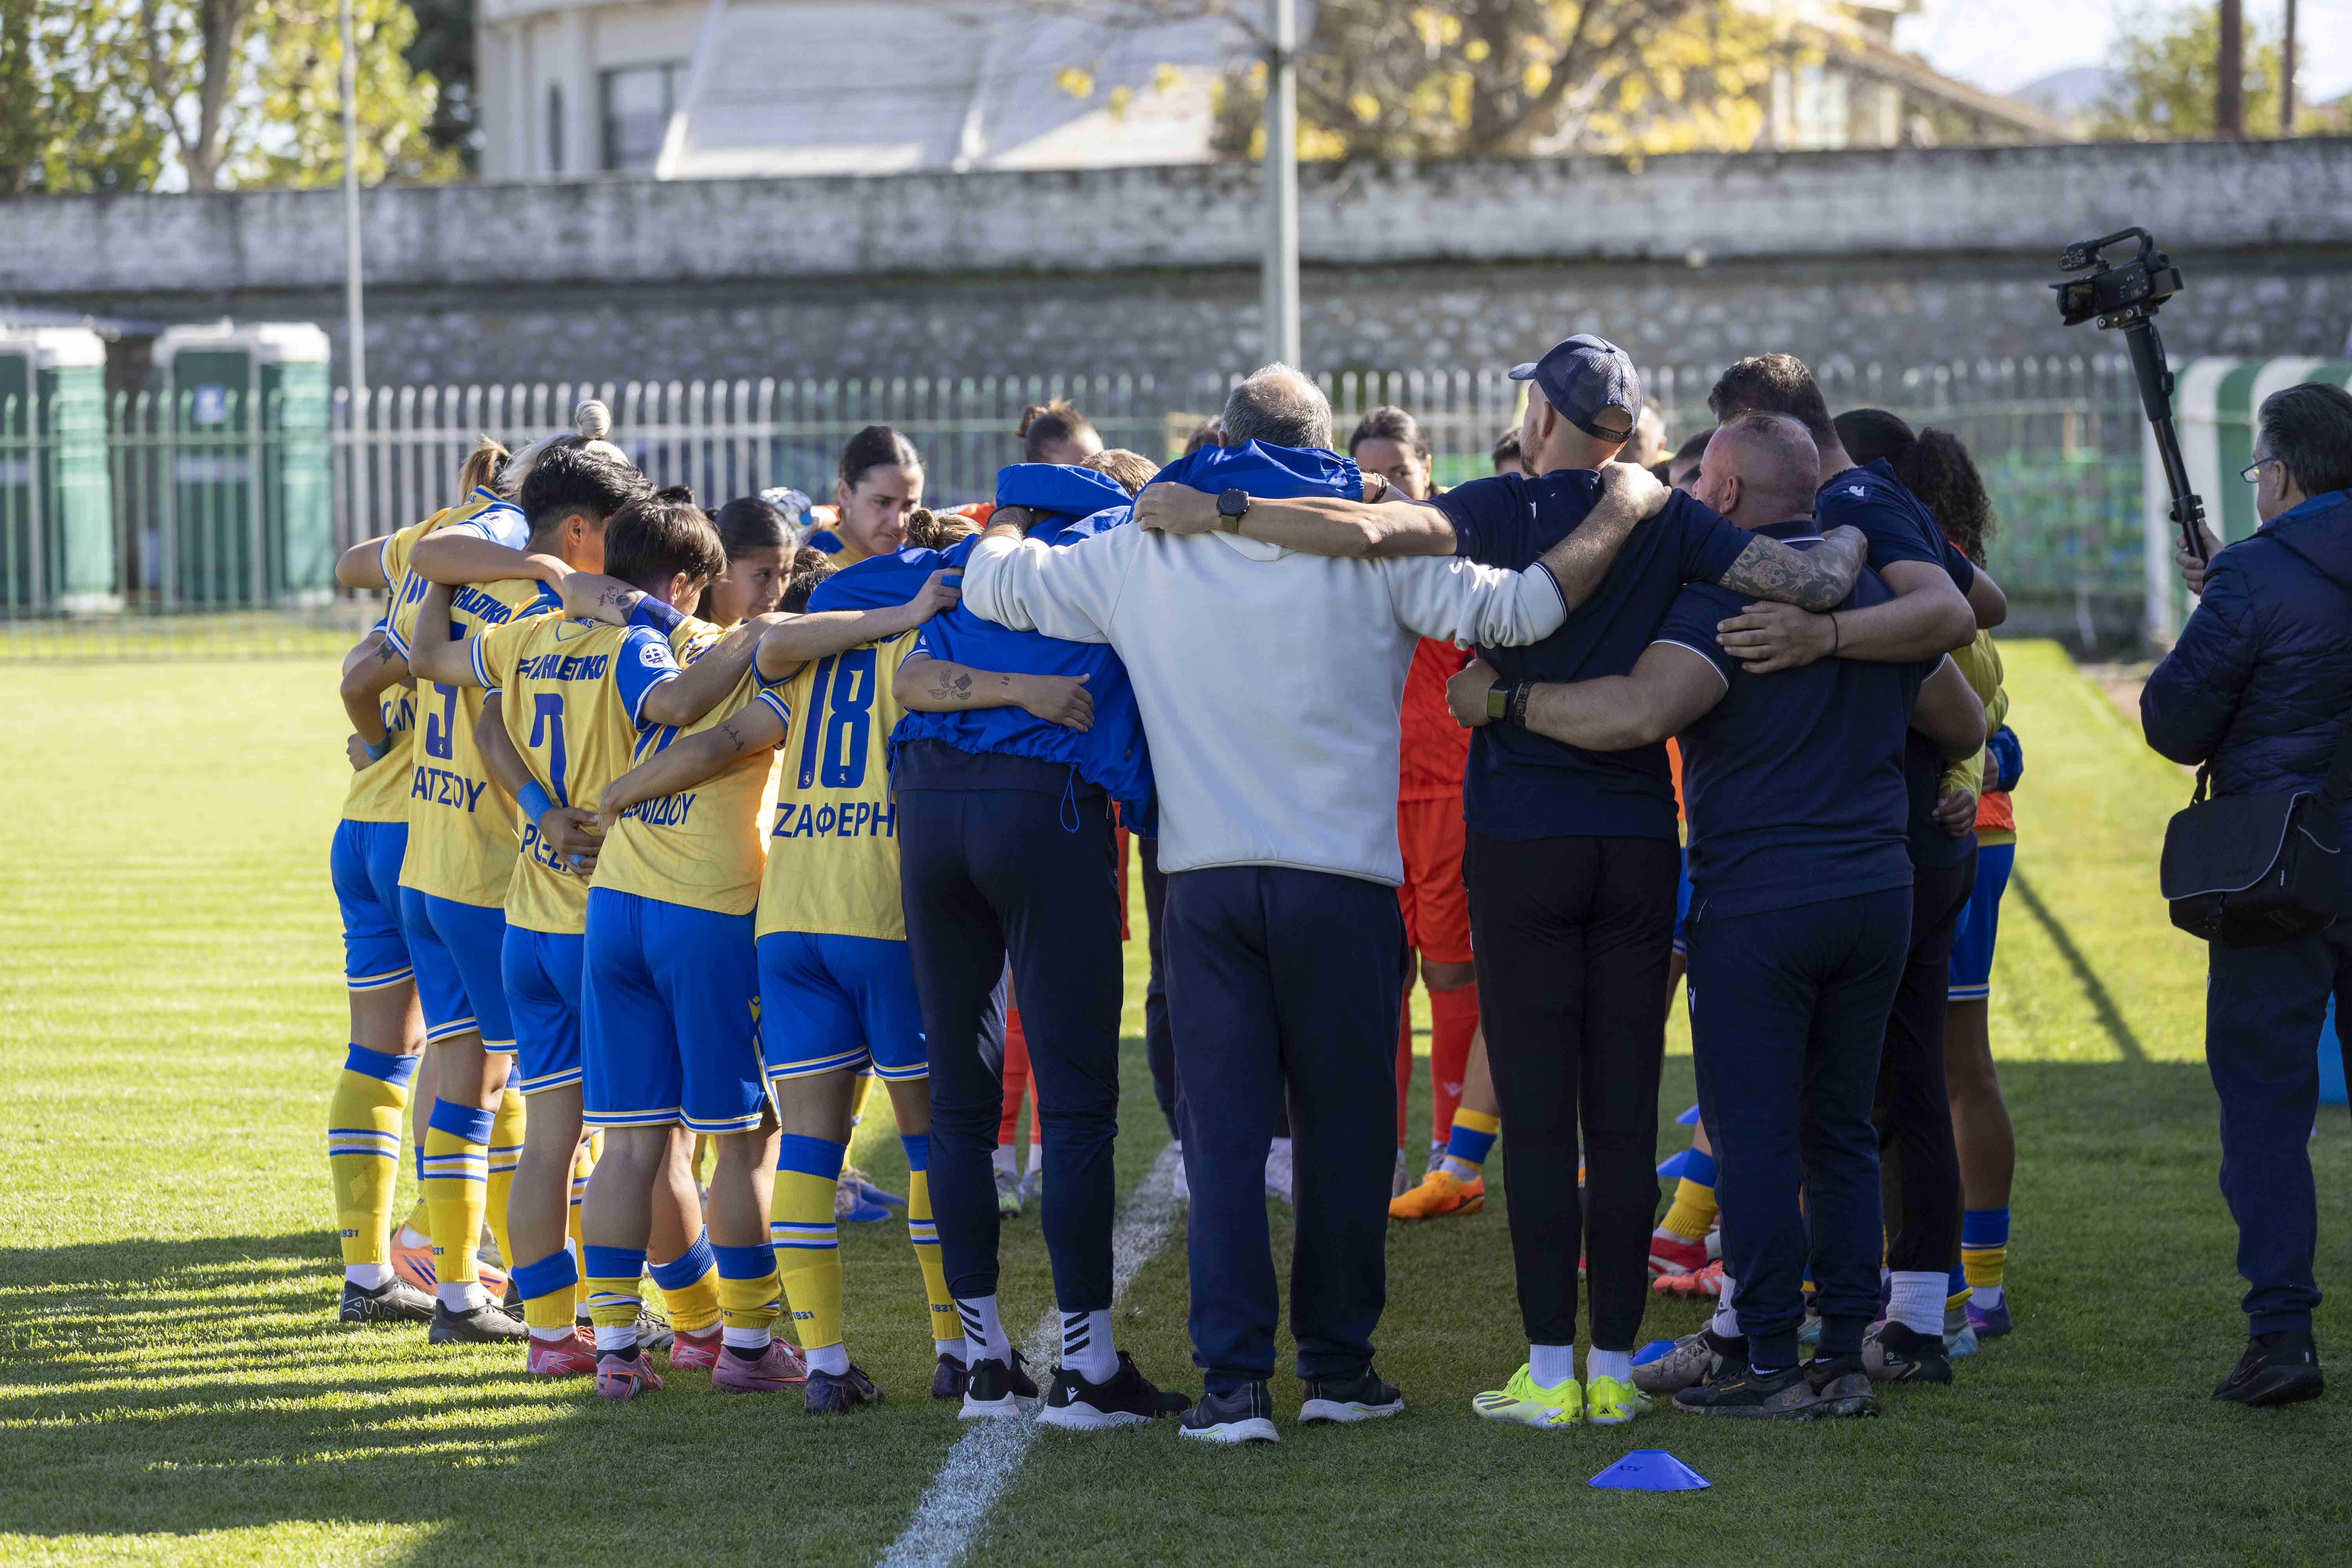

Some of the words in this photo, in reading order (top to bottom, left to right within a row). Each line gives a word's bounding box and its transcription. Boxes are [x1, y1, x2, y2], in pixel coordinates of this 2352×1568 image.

[797, 648, 877, 789] 18
[411, 763, 487, 813] ΑΤΣΟΥ
[771, 801, 896, 838] ΖΑΦΕΡΗ
[931, 1304, 953, 1312] 1931
